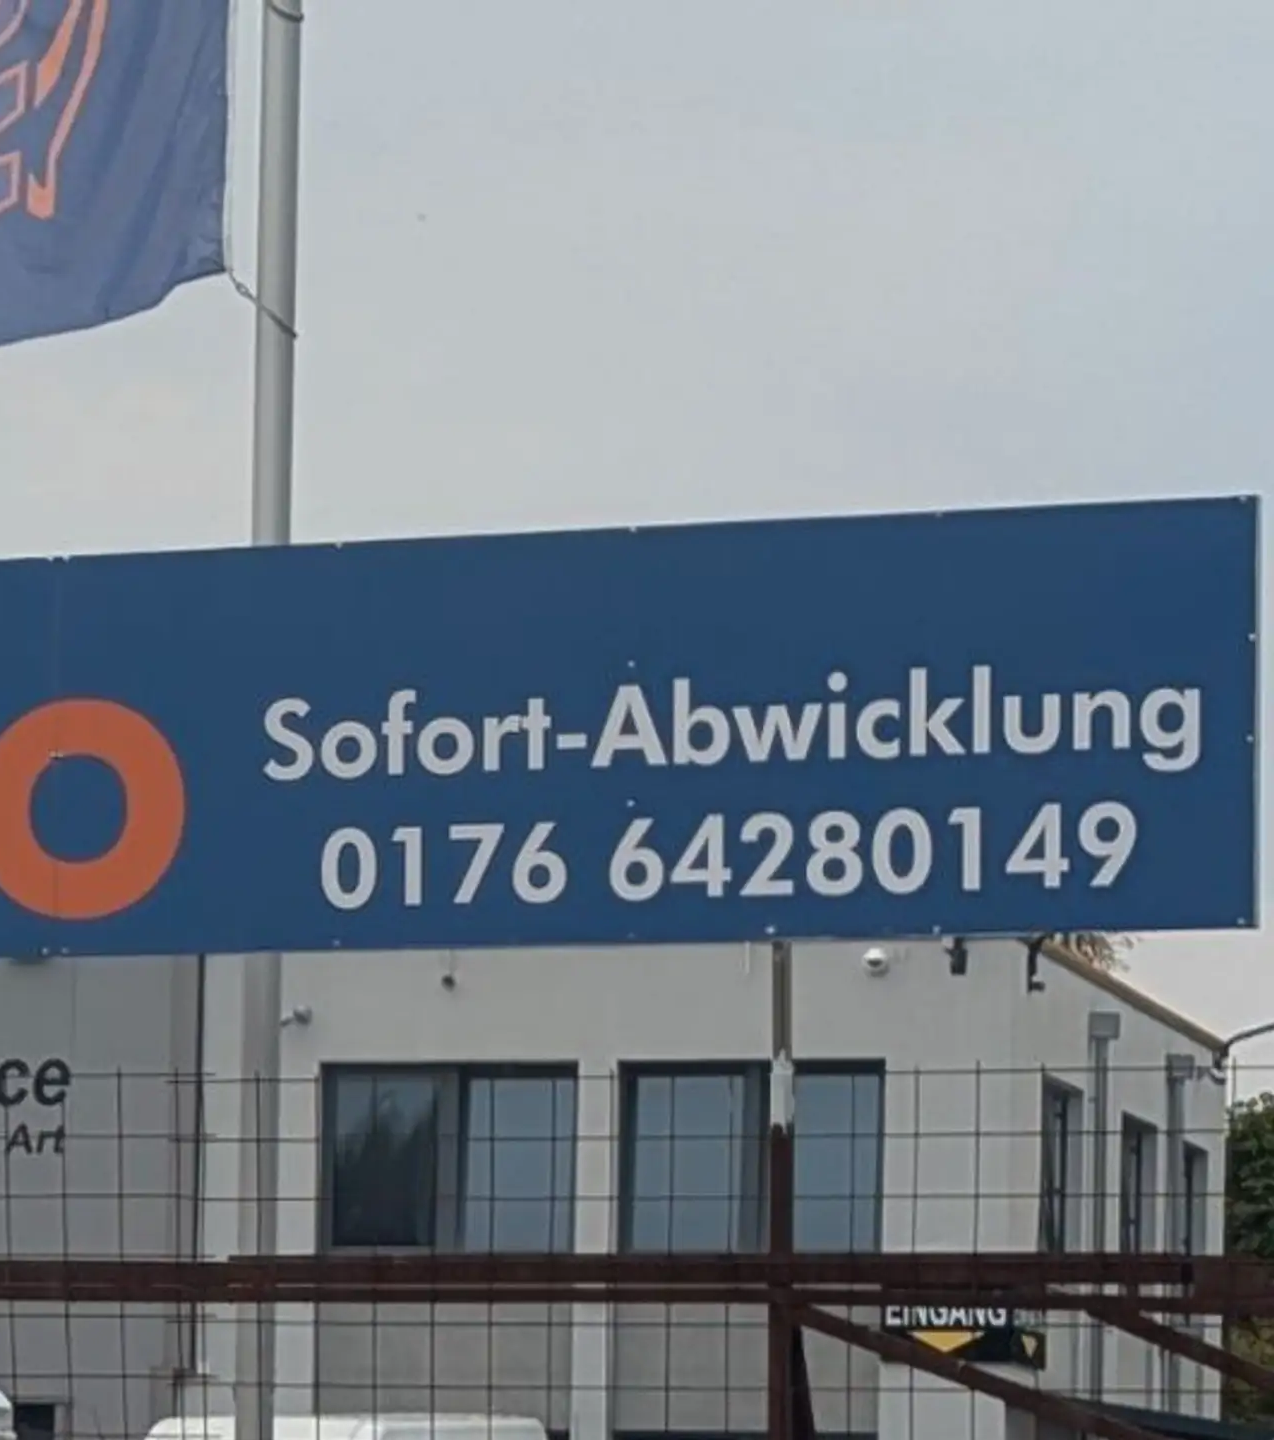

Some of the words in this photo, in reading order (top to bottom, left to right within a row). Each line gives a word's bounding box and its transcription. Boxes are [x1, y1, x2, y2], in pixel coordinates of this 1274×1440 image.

[262, 665, 1203, 781] Sofort-Abwicklung
[320, 819, 569, 910] 0176
[608, 801, 1137, 902] 64280149
[4, 1123, 66, 1156] Art
[884, 1304, 1008, 1327] EINGANG
